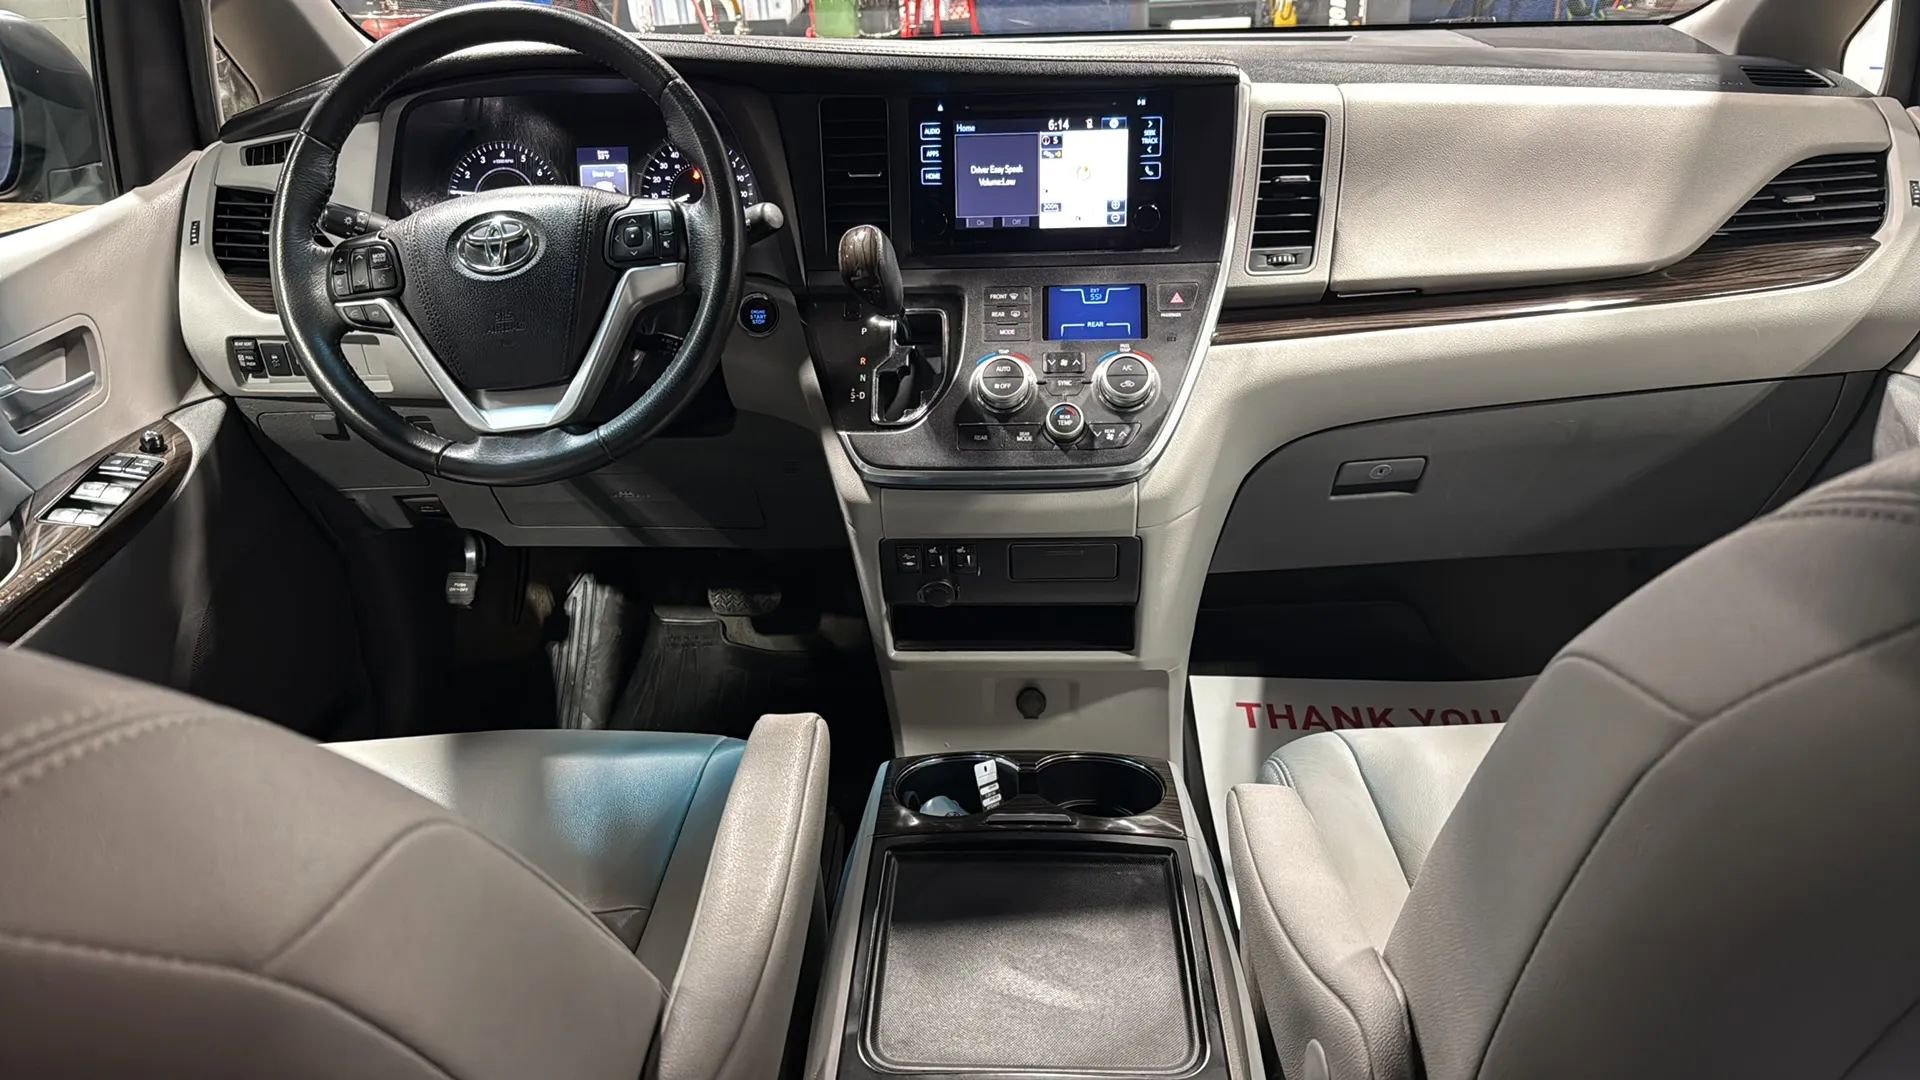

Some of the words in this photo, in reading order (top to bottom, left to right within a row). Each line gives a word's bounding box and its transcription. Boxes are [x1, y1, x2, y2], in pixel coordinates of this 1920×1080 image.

[956, 123, 976, 133] Home
[1047, 118, 1070, 131] 6:14
[924, 127, 941, 135] AUDIO
[499, 150, 506, 159] 4
[520, 154, 527, 163] 5
[670, 151, 680, 159] 40
[479, 155, 486, 164] 3
[659, 162, 669, 170] 30
[970, 165, 989, 174] Driver
[990, 164, 1004, 175] Easy
[1005, 164, 1024, 175] Speak
[464, 171, 471, 179] 2
[536, 168, 543, 177] 6
[925, 172, 941, 180] HOME
[652, 175, 662, 183] 20
[651, 192, 659, 200] 10
[861, 327, 868, 335] P
[860, 357, 867, 365] R
[860, 374, 867, 382] N
[1236, 702, 1396, 732] THANK
[1408, 708, 1503, 726] YOU
